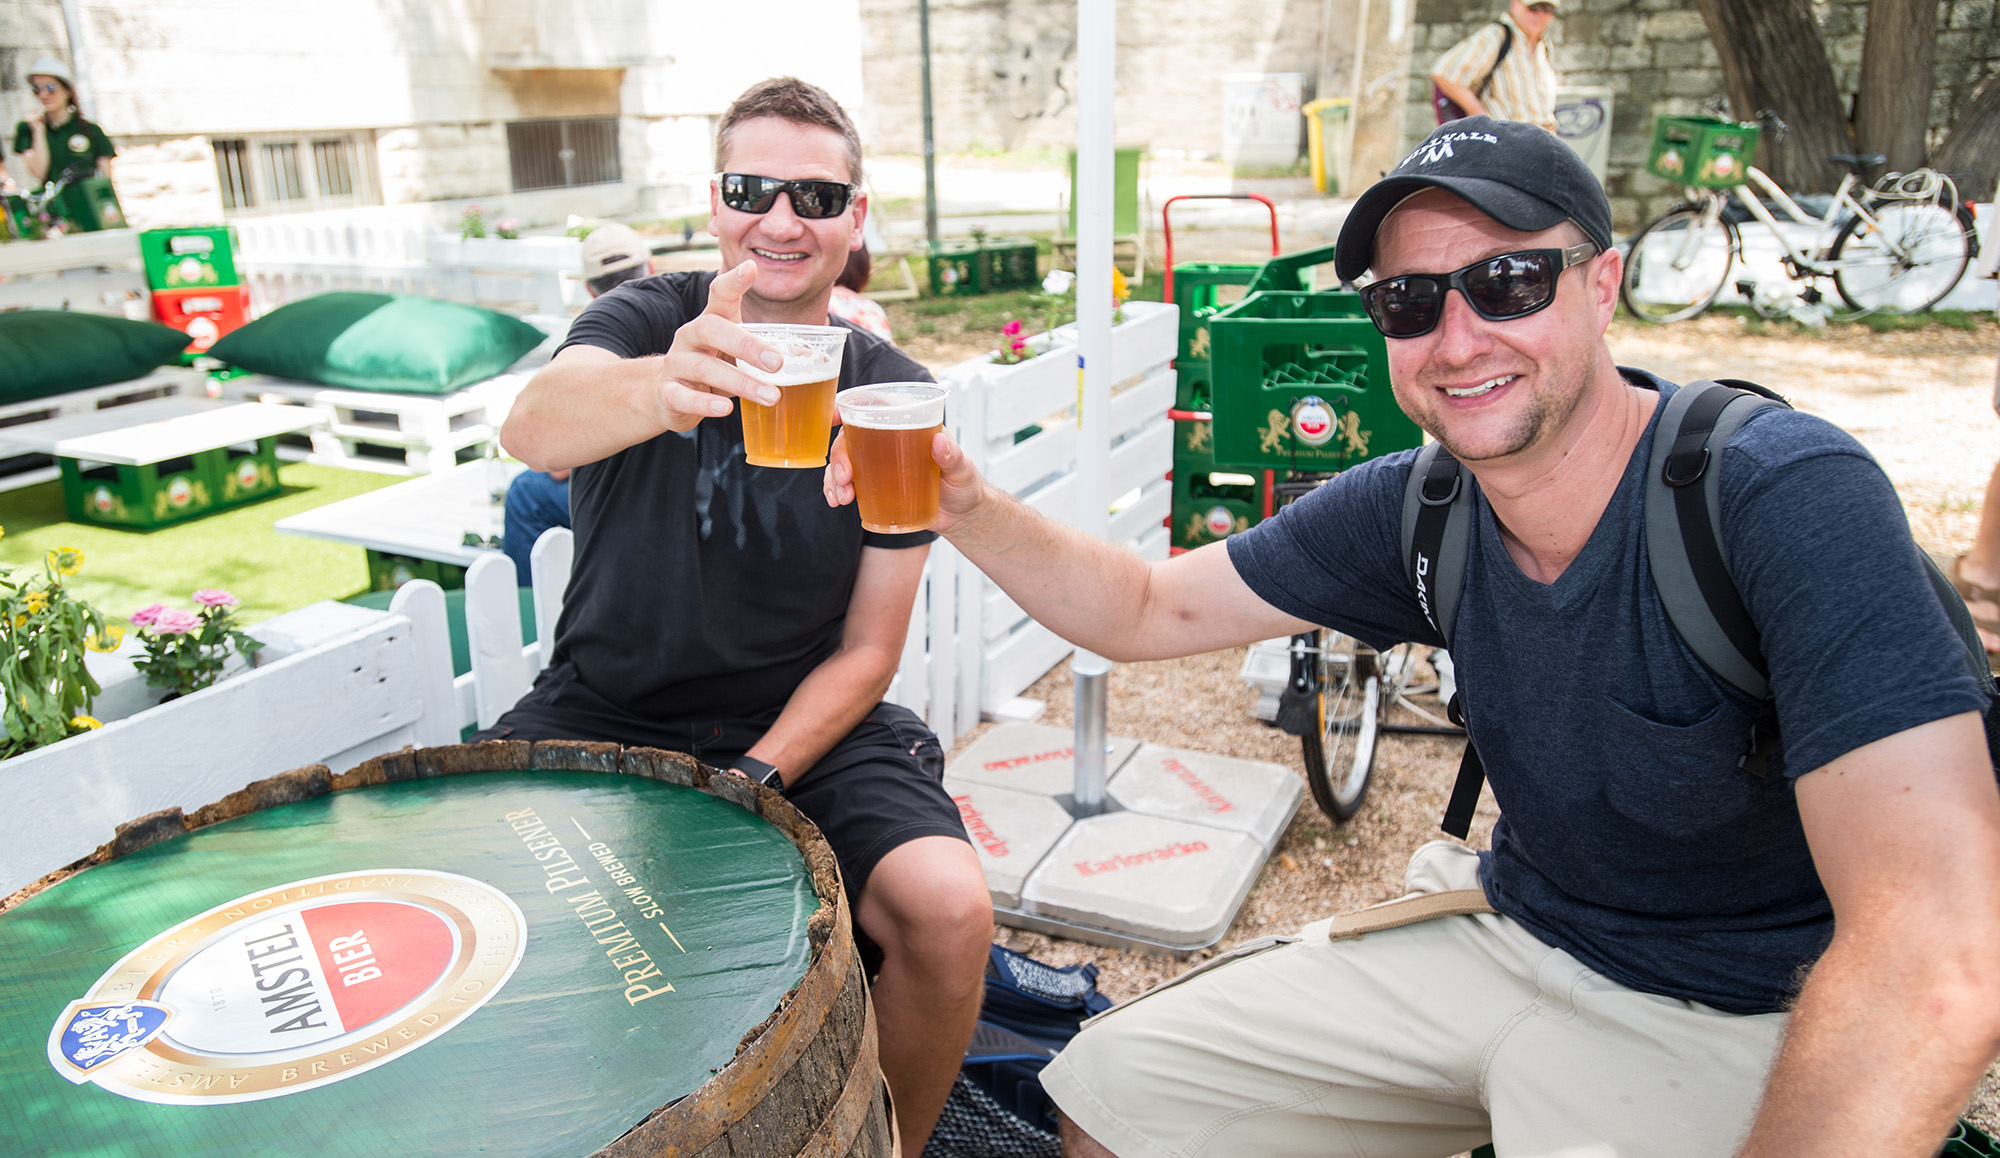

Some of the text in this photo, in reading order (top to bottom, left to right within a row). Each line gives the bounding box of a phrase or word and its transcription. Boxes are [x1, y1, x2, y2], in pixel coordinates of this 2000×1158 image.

[223, 876, 416, 921] TRADITION
[504, 806, 676, 1007] PREMIUM PILSENER
[587, 841, 665, 920] SLOW BREWED
[243, 923, 328, 1034] AMSTEL
[328, 928, 383, 988] BIER
[447, 979, 486, 1005] TO
[279, 1011, 442, 1083] BREWED
